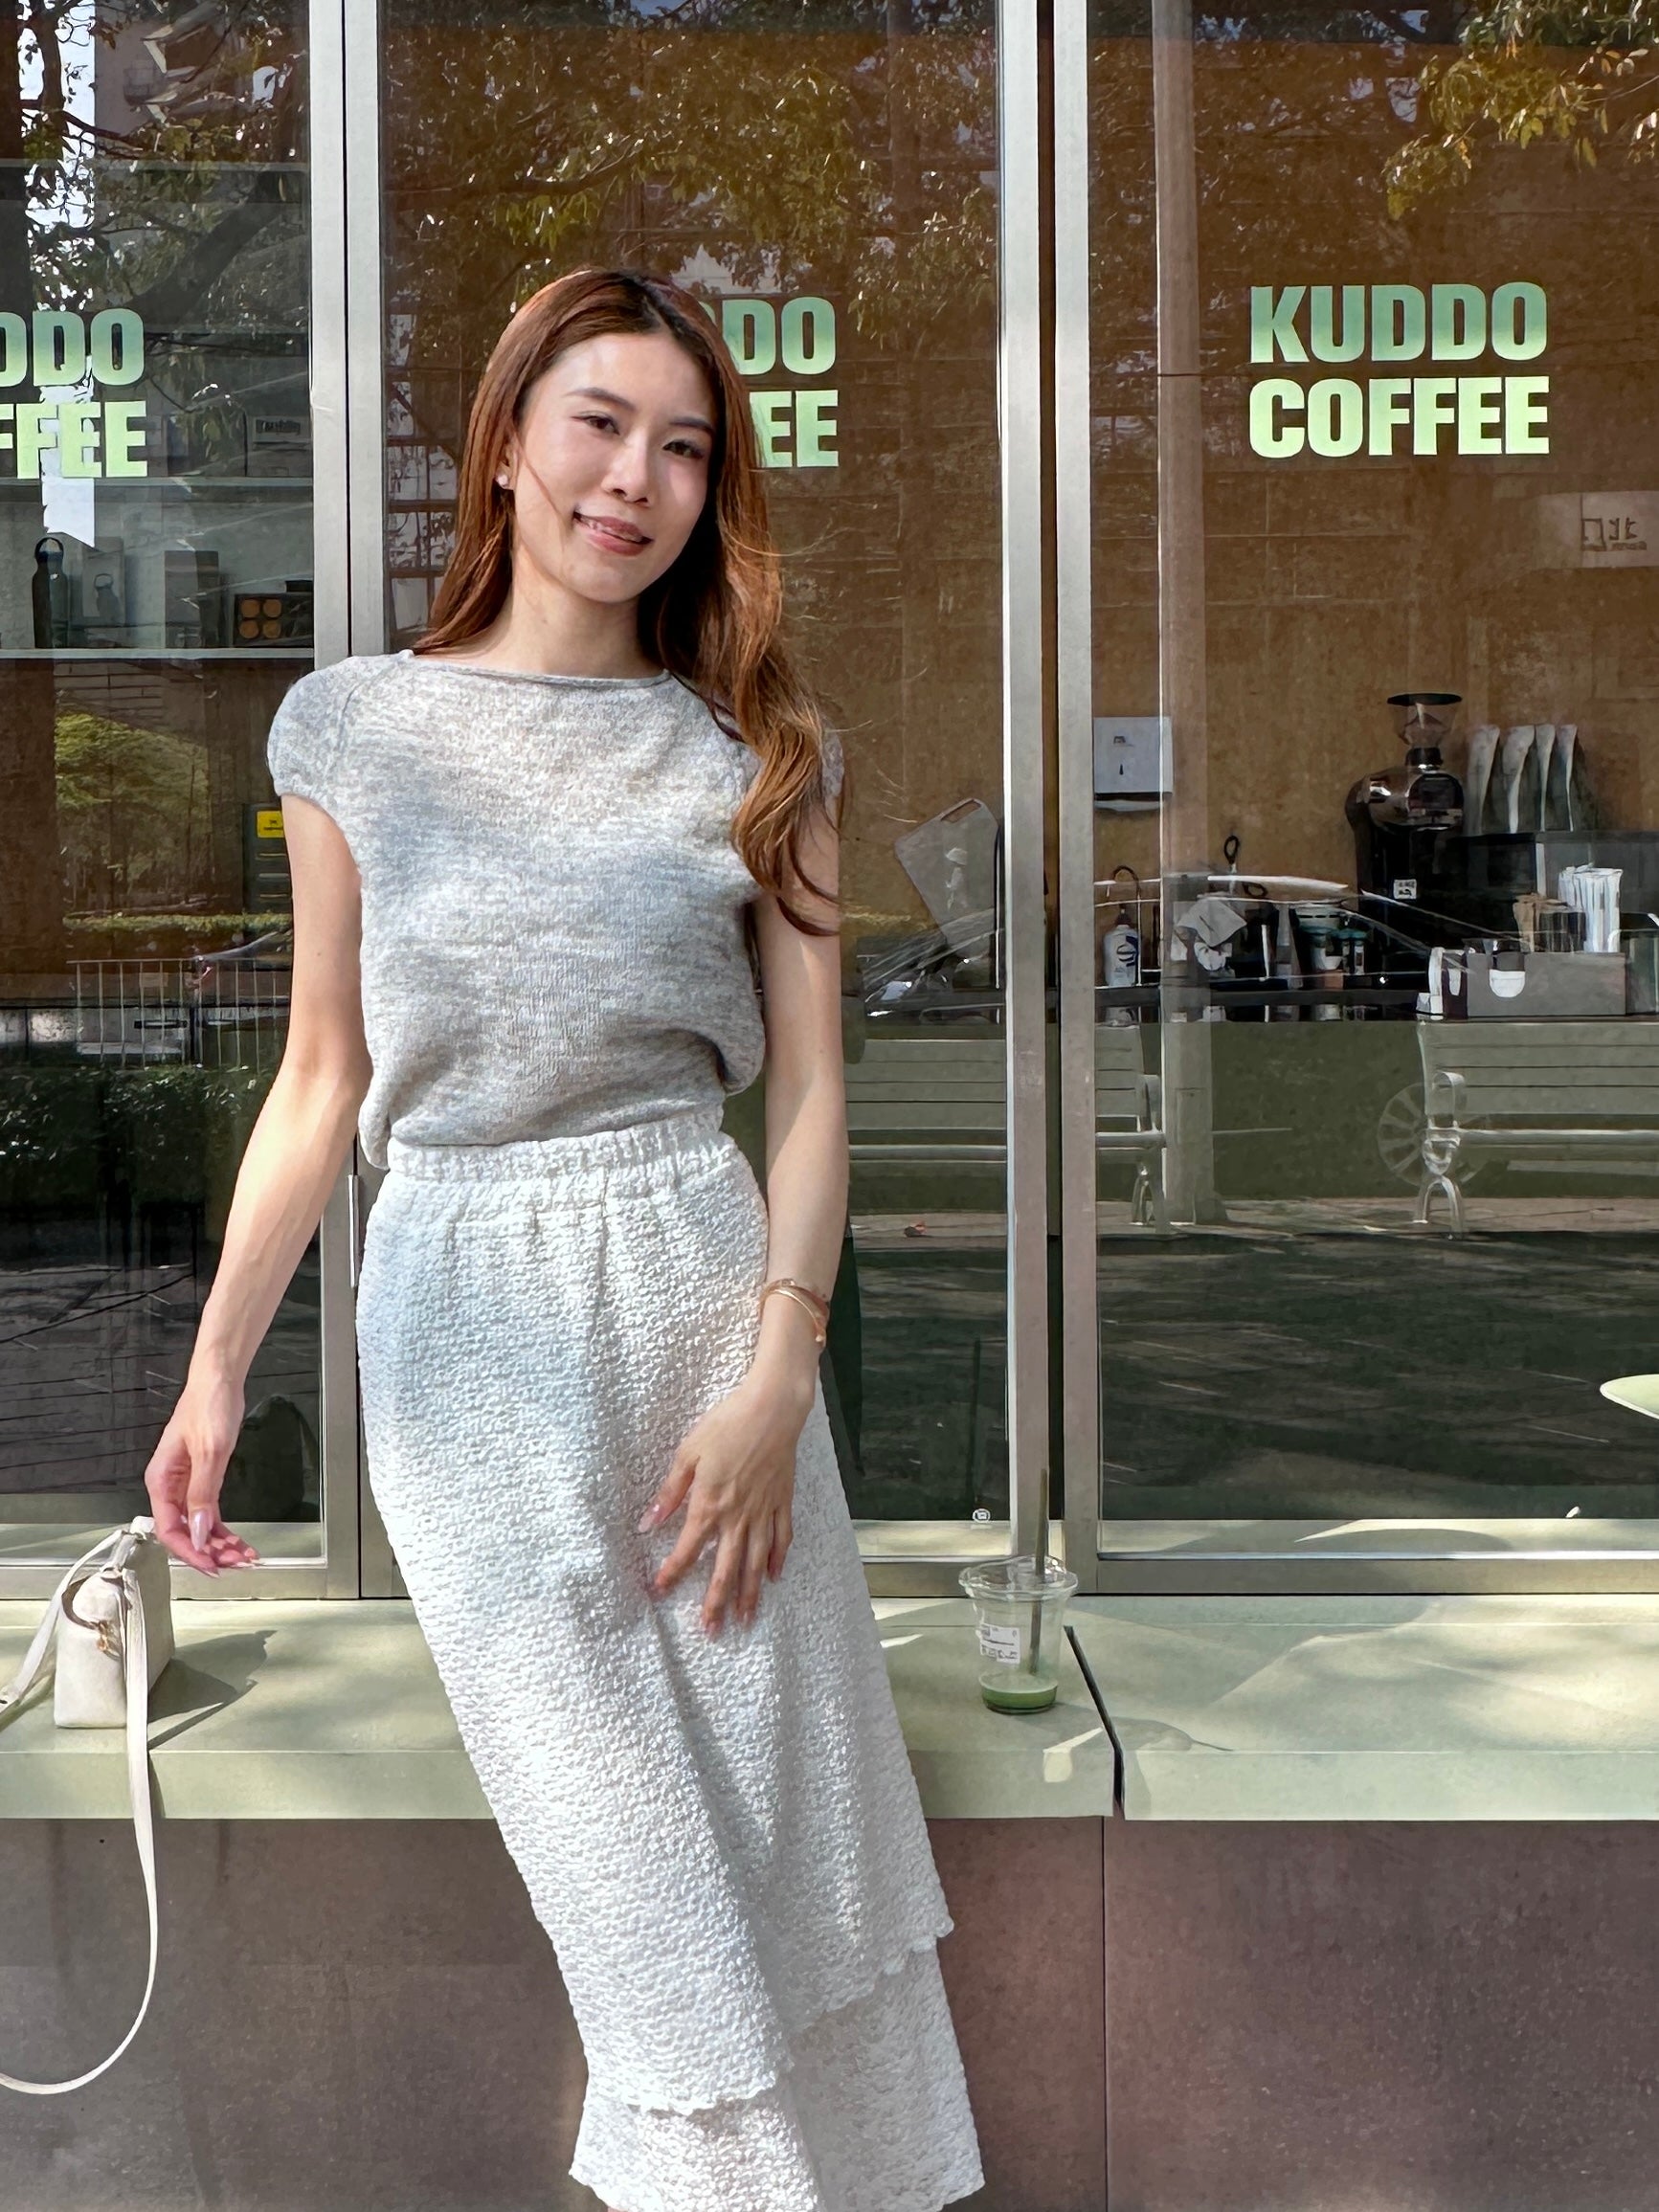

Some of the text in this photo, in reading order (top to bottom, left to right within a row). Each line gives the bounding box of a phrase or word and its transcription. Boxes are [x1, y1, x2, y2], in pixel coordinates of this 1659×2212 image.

[700, 297, 836, 375] DO
[1250, 281, 1548, 363] KUDDO
[1249, 375, 1550, 458] COFFEE
